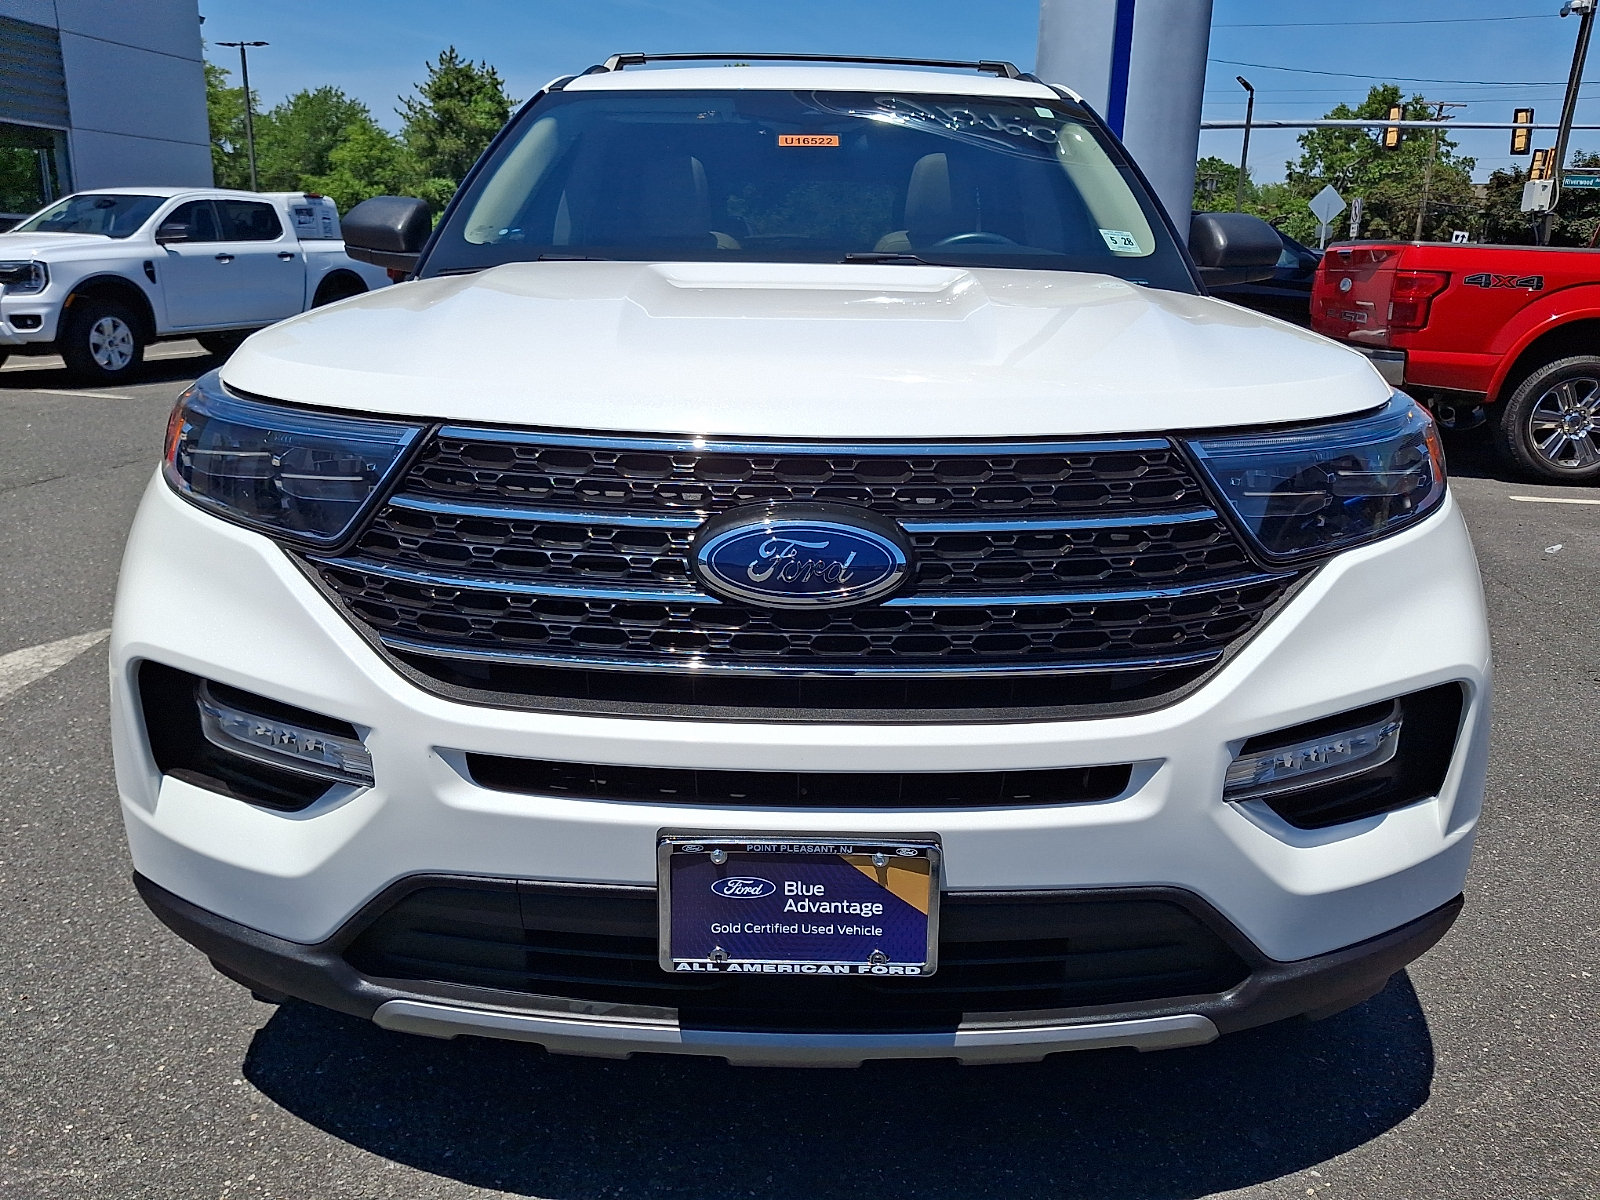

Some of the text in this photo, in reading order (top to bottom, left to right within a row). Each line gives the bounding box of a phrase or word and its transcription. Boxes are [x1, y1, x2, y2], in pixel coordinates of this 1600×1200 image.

[784, 137, 833, 145] U16522
[1110, 236, 1134, 246] 5 28
[747, 537, 857, 584] Ford
[746, 844, 853, 854] POINT PLEASANT, NJ
[723, 879, 764, 895] Ford
[784, 881, 825, 896] Blue
[783, 898, 883, 917] Advantage
[711, 922, 883, 936] Gold Certified Used Vehicle
[676, 962, 921, 975] ALL AMERICAN FORD
